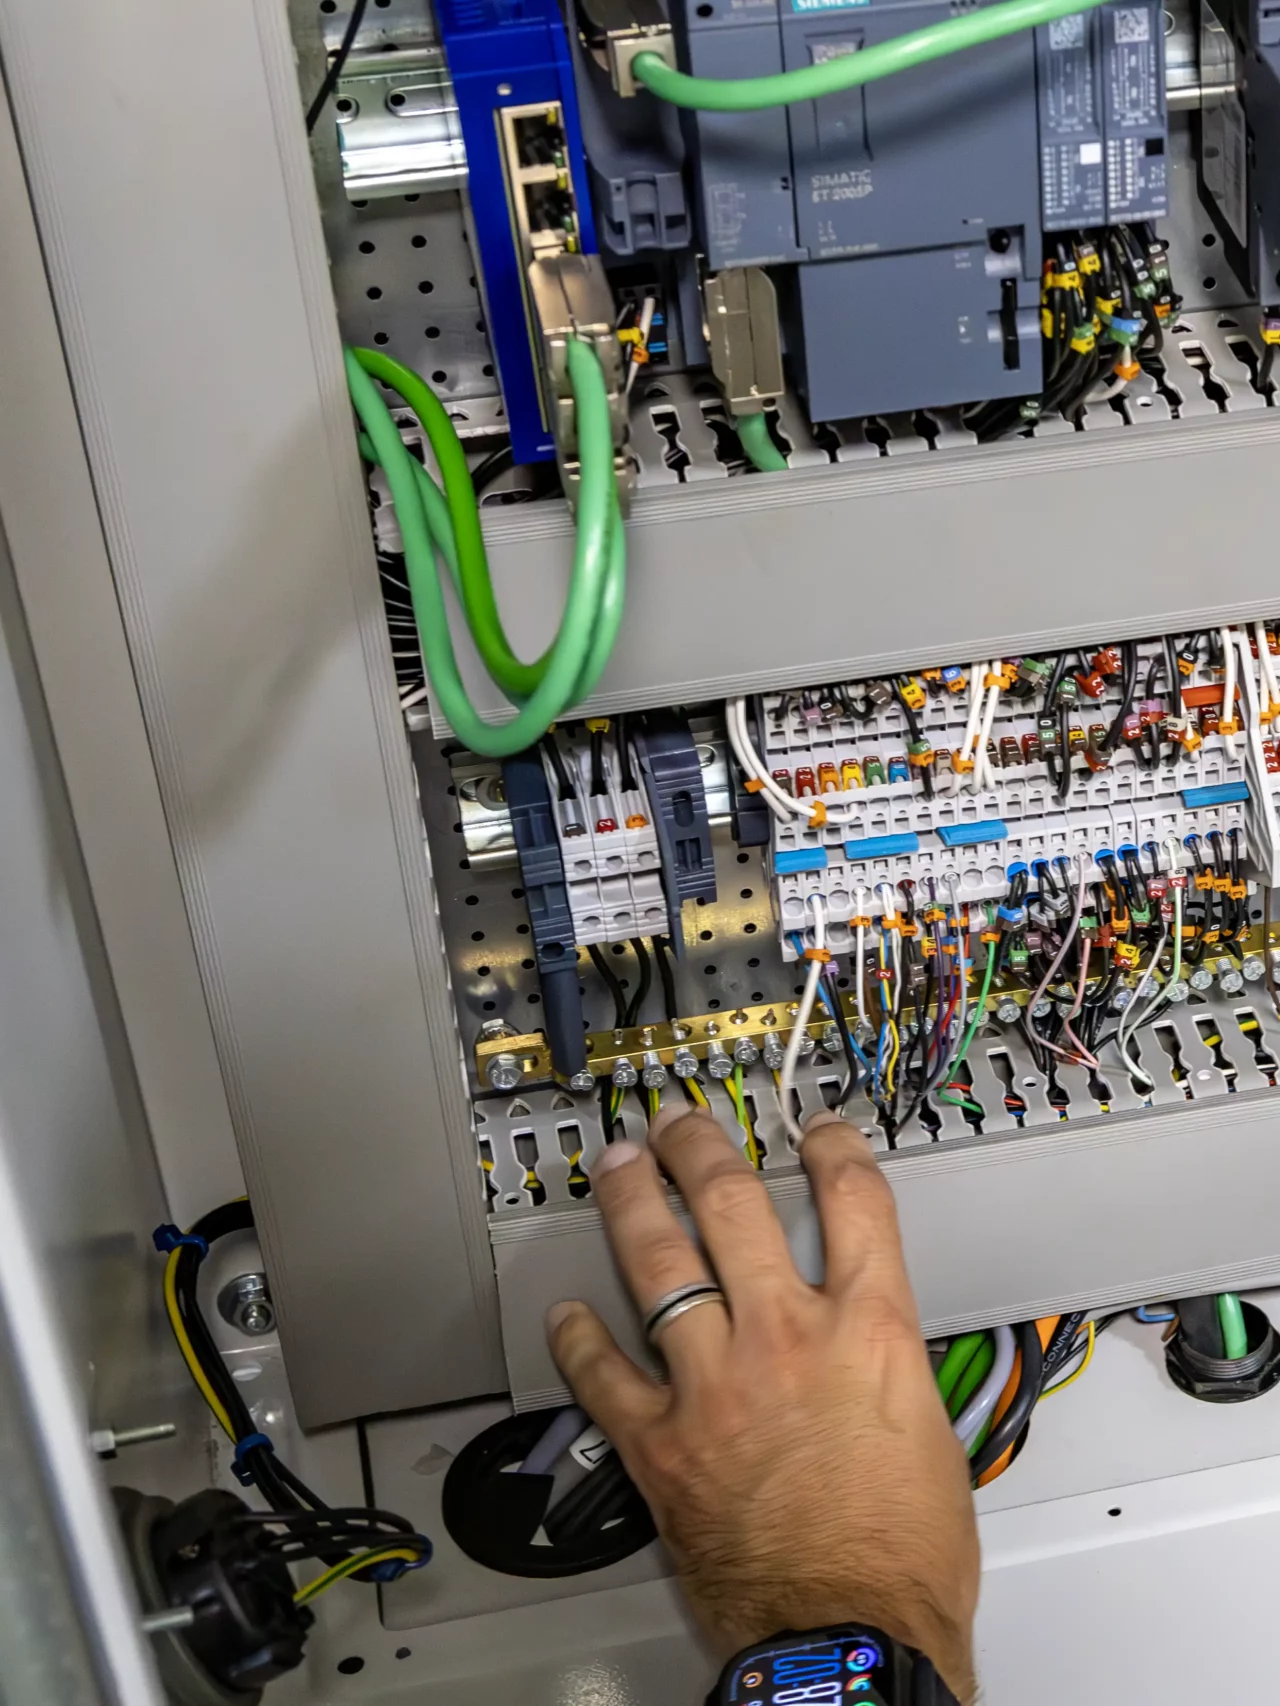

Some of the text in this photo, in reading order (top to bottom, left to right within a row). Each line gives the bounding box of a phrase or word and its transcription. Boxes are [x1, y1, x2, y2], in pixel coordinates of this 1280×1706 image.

[811, 170, 872, 188] SIMATIC
[1040, 719, 1057, 749] 150
[1126, 718, 1141, 737] 27
[1262, 740, 1278, 769] 222
[1171, 868, 1185, 886] 28
[1151, 883, 1165, 897] 27
[912, 964, 925, 983] 11
